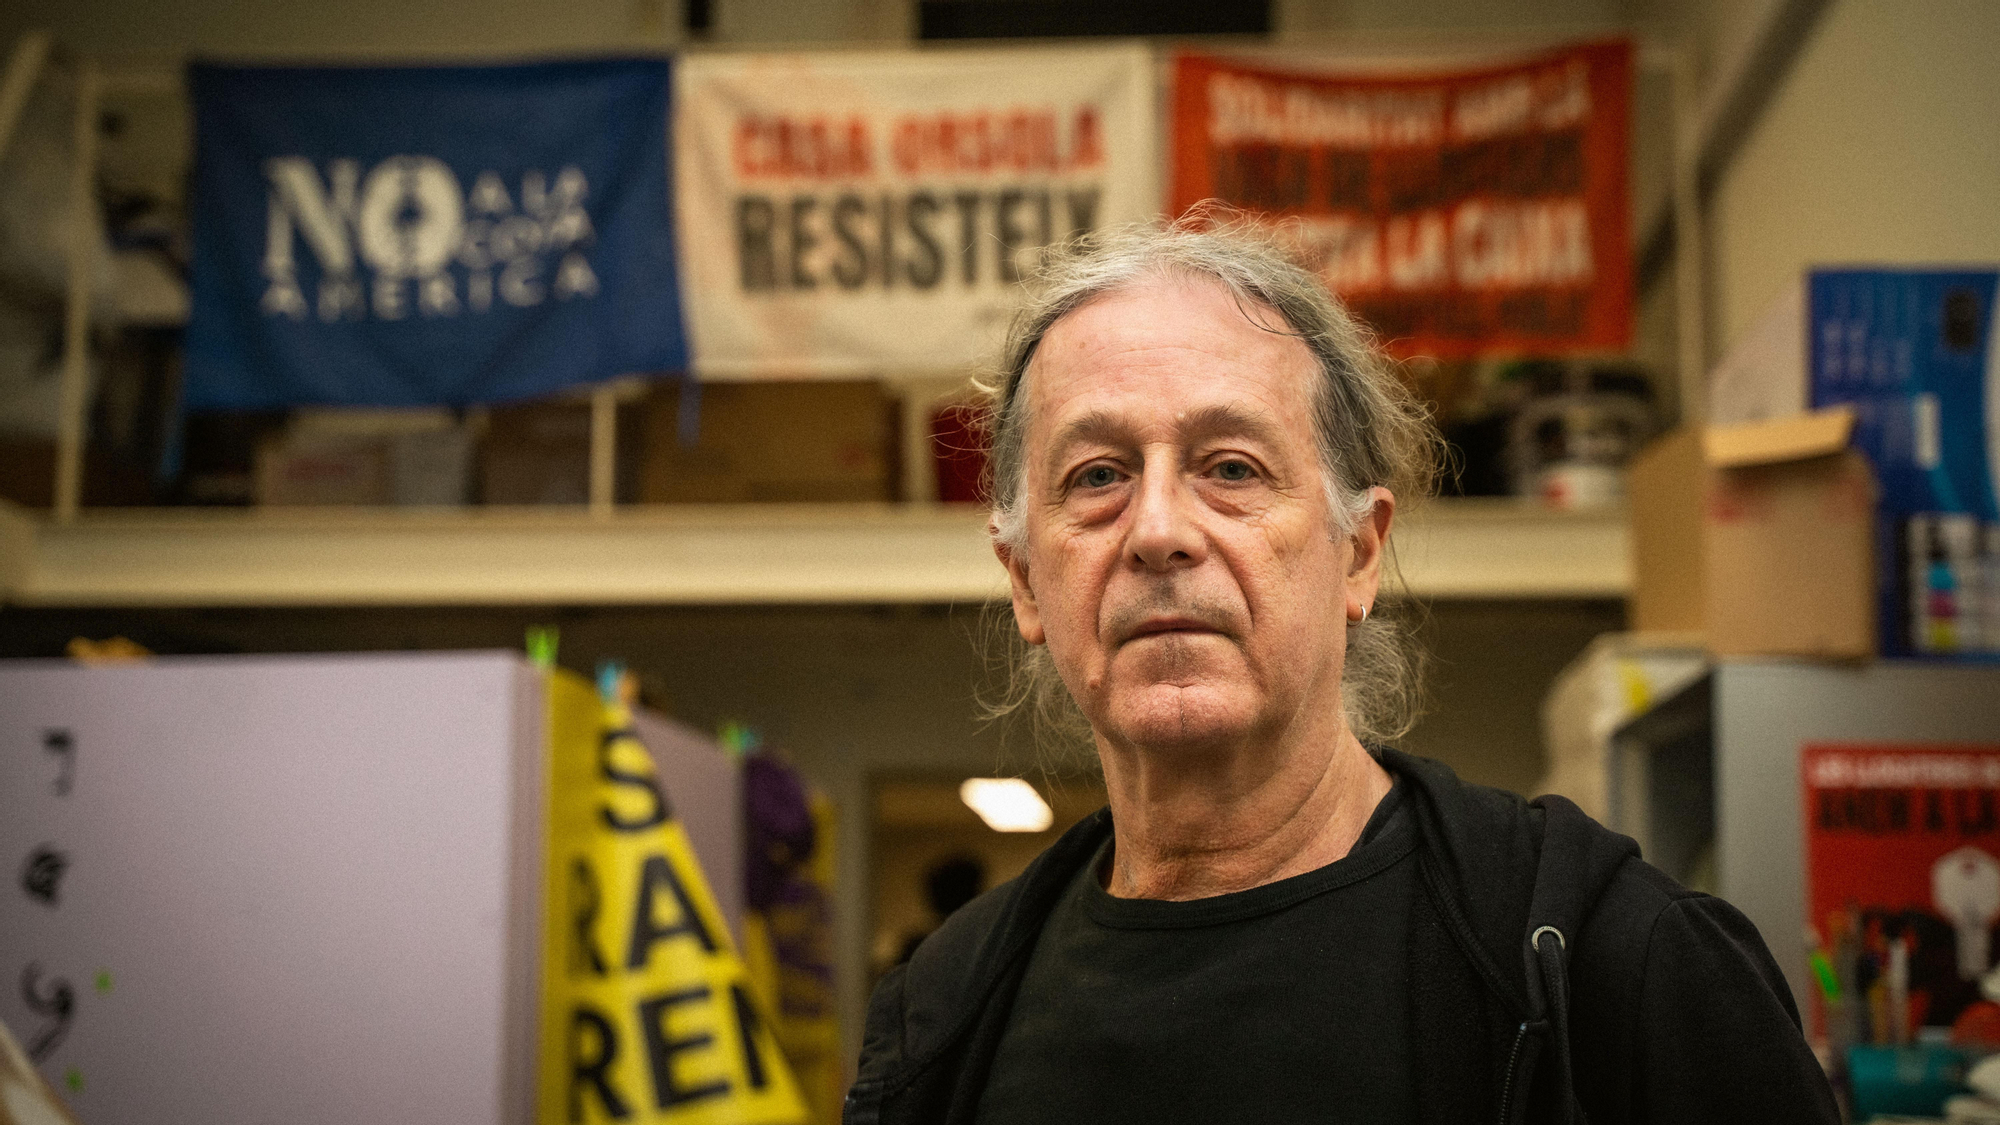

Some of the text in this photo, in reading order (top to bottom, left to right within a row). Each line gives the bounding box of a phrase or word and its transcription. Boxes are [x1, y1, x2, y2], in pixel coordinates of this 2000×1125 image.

[732, 102, 1105, 179] CASA ORSOLA
[262, 155, 464, 283] NO
[468, 165, 590, 219] A LA
[260, 252, 600, 324] AMERICA
